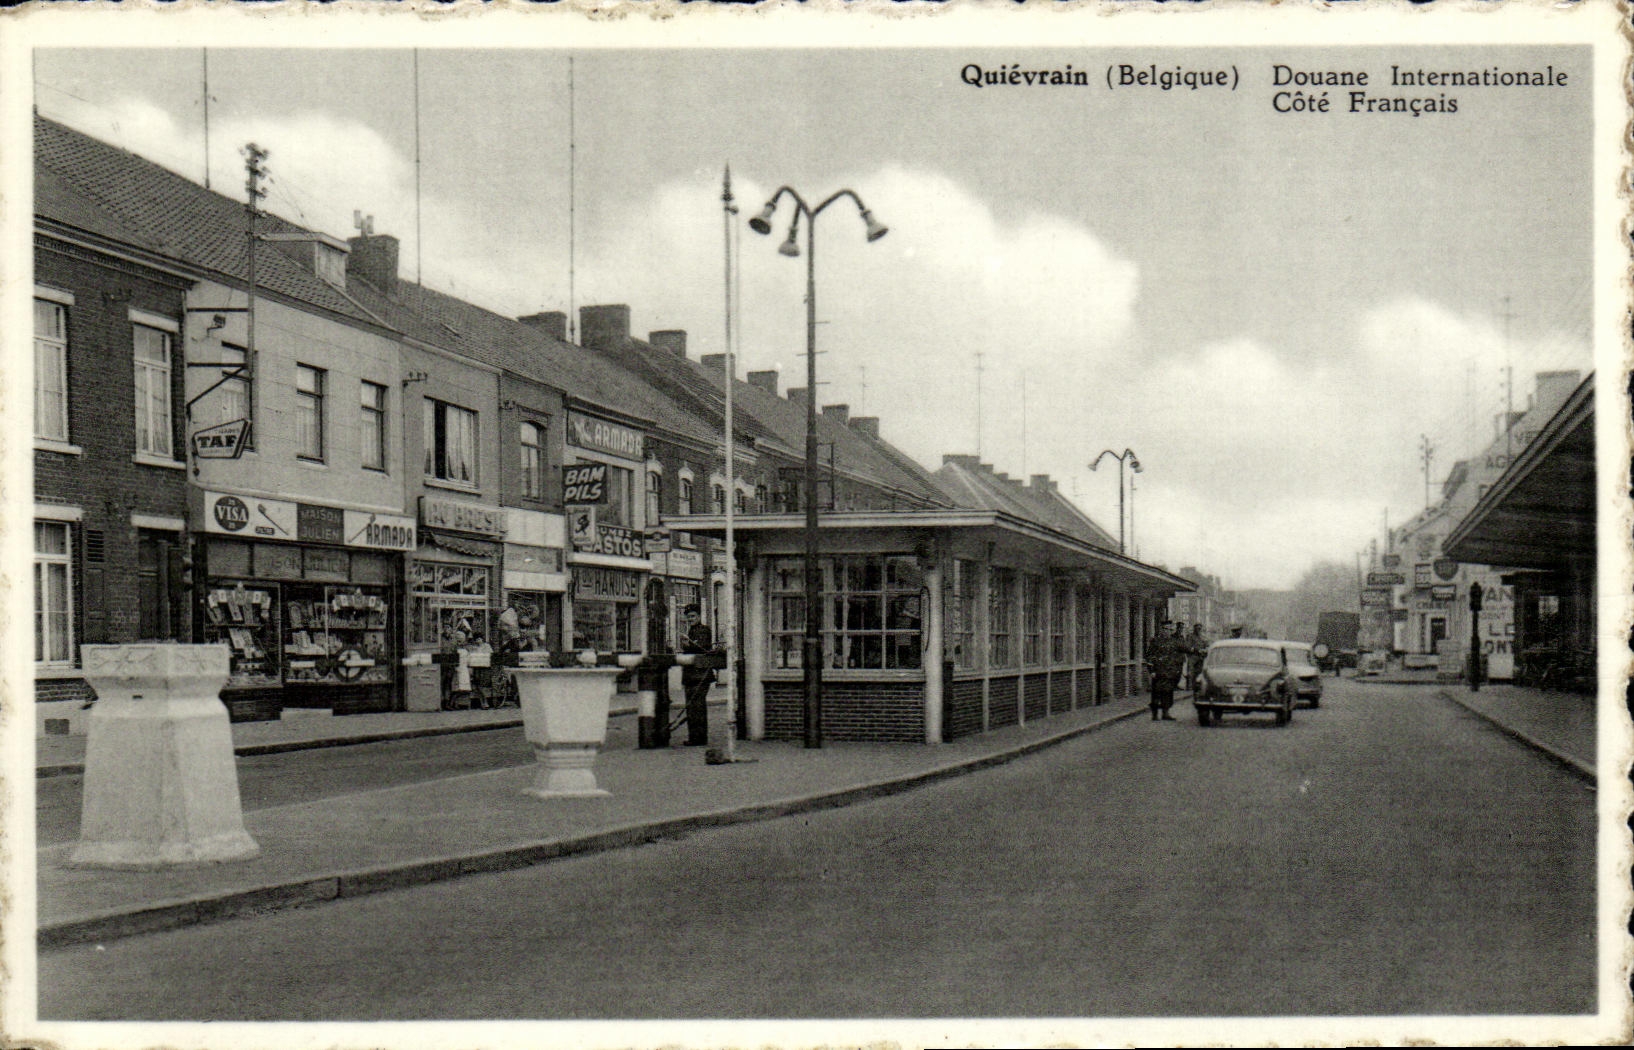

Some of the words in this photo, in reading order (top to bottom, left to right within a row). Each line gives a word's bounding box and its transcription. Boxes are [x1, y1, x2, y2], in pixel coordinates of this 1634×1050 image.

[197, 435, 238, 448] TAF
[595, 423, 643, 456] ARMADA
[564, 466, 605, 485] BAM
[563, 483, 602, 501] PILS
[214, 505, 249, 522] VISA
[301, 525, 340, 541] JULIEN
[367, 523, 413, 547] ARMADA
